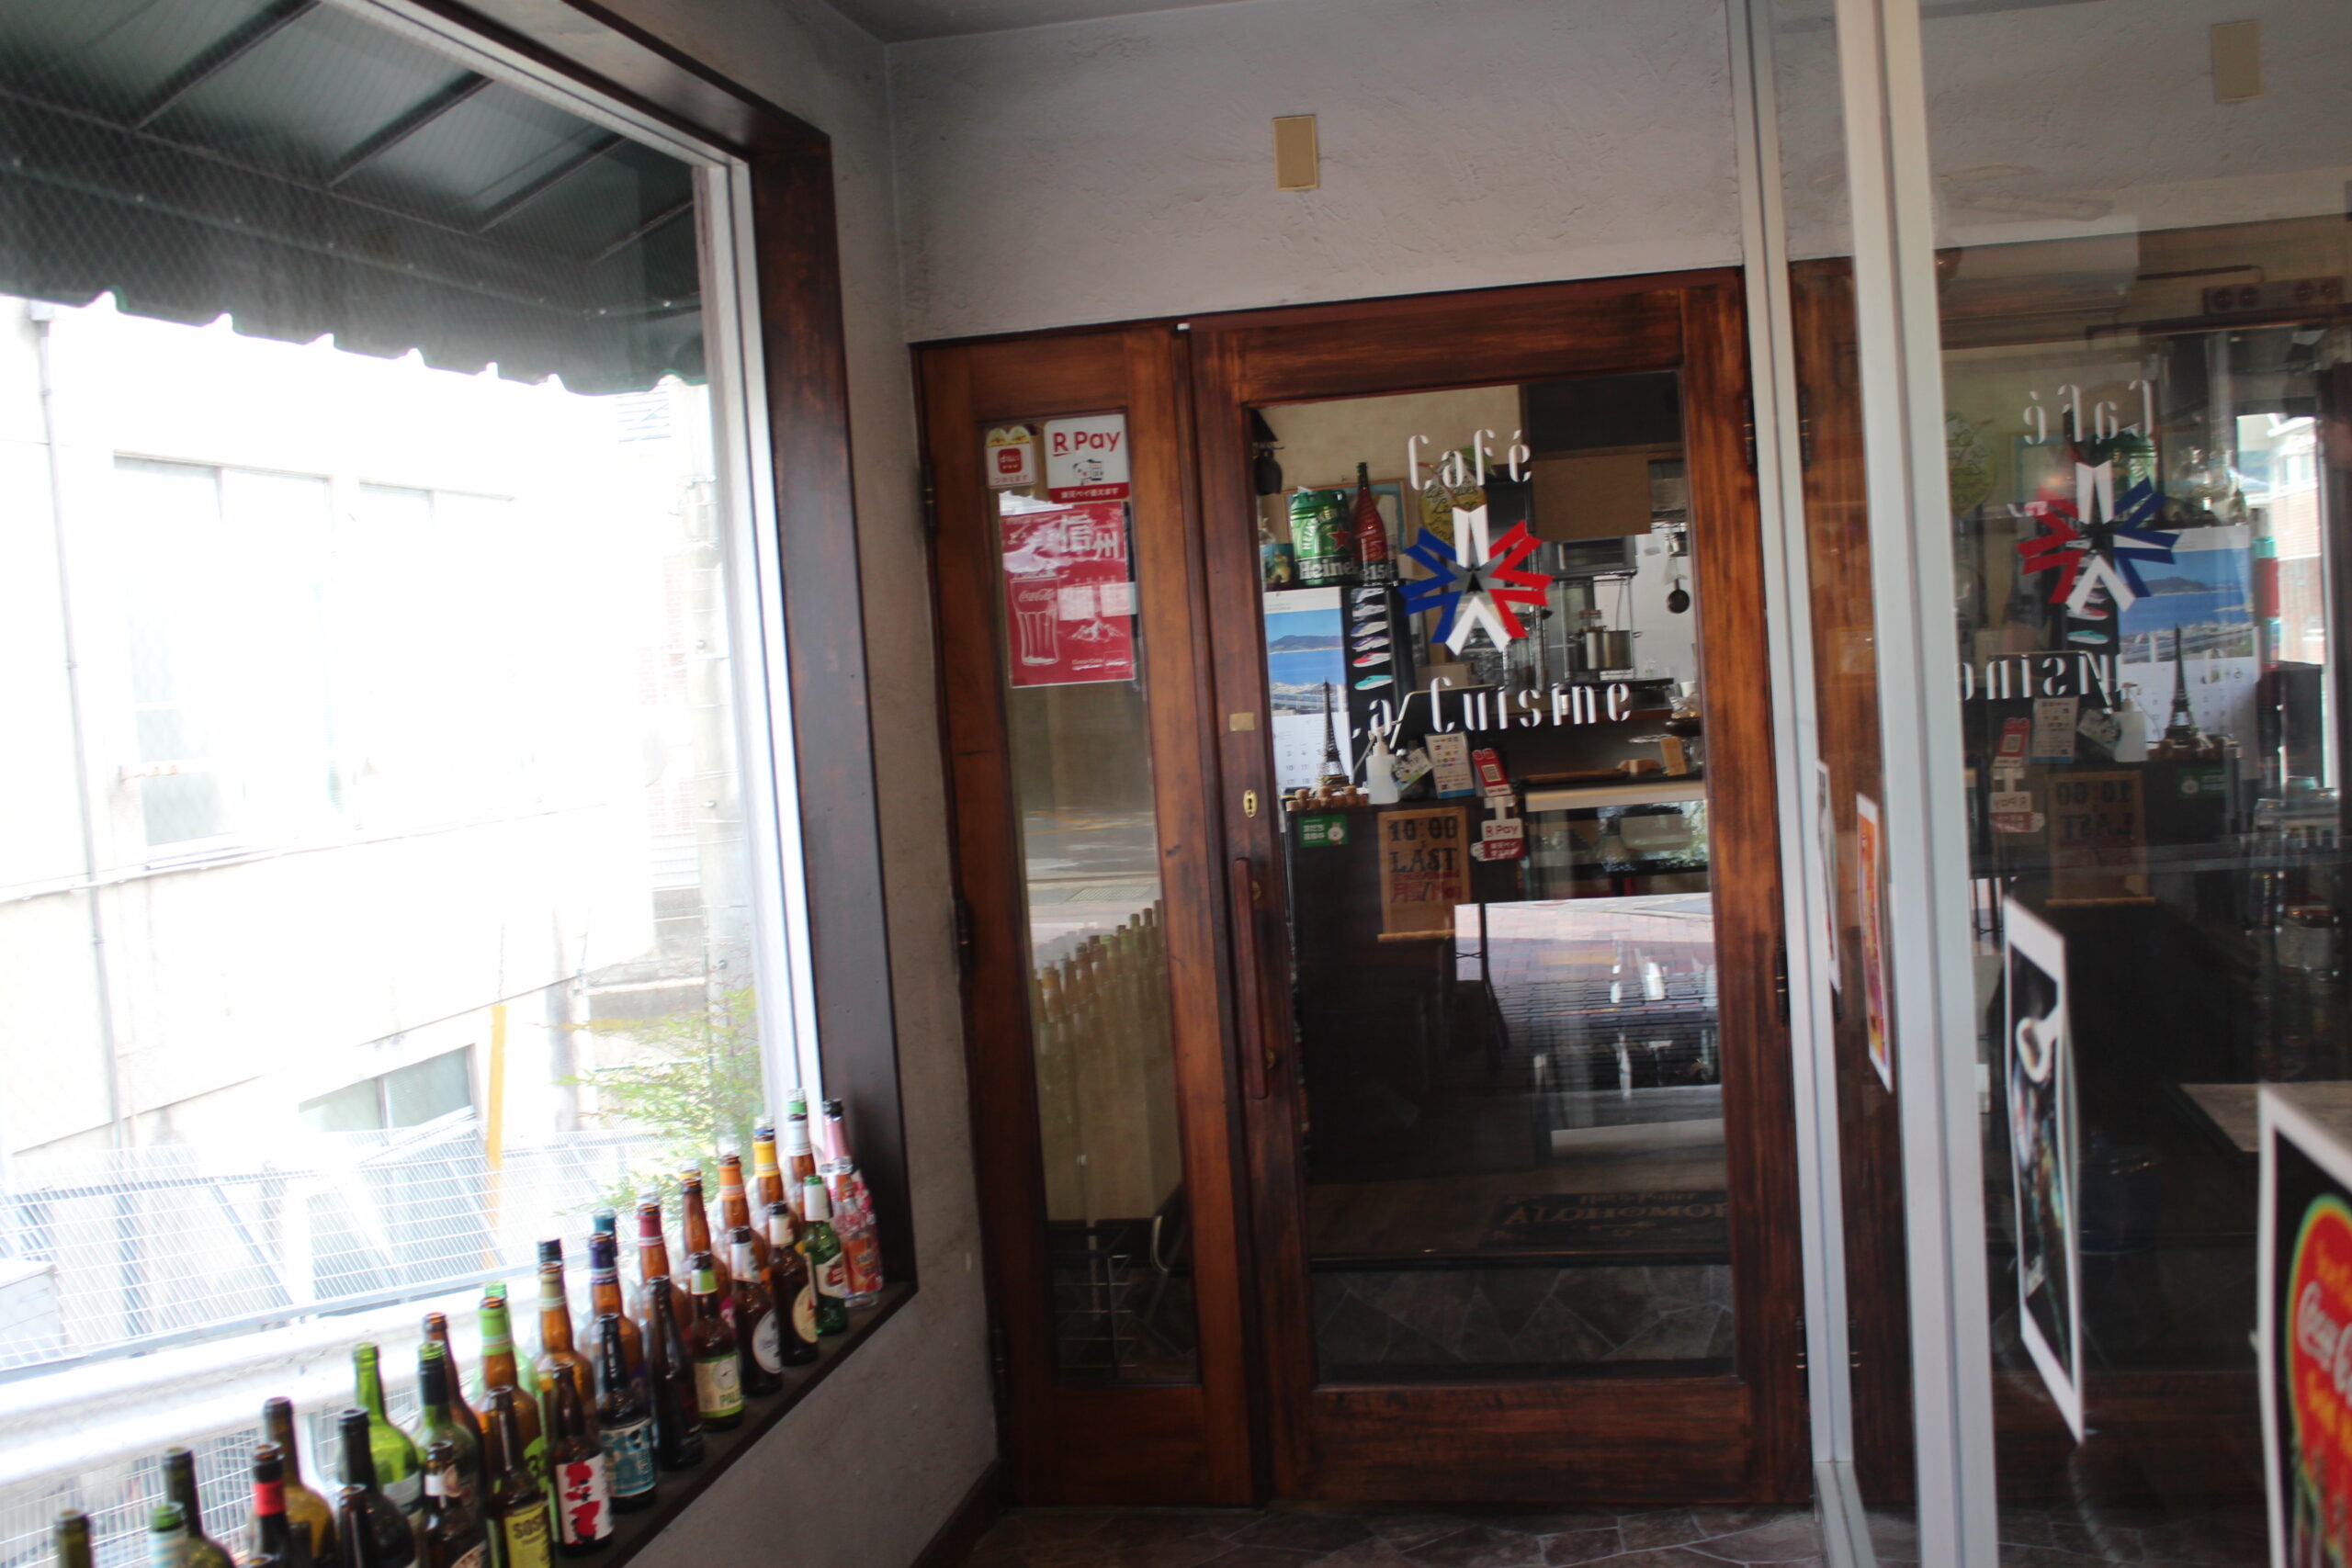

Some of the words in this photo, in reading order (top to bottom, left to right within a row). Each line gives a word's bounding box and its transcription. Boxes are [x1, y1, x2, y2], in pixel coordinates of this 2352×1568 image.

[1052, 432, 1071, 457] R
[1073, 430, 1122, 453] Pay
[1408, 428, 1532, 491] Café
[1430, 676, 1632, 733] Cuisine
[1388, 817, 1458, 841] 10:00
[1496, 824, 1519, 835] Pay
[1389, 848, 1458, 873] LAST
